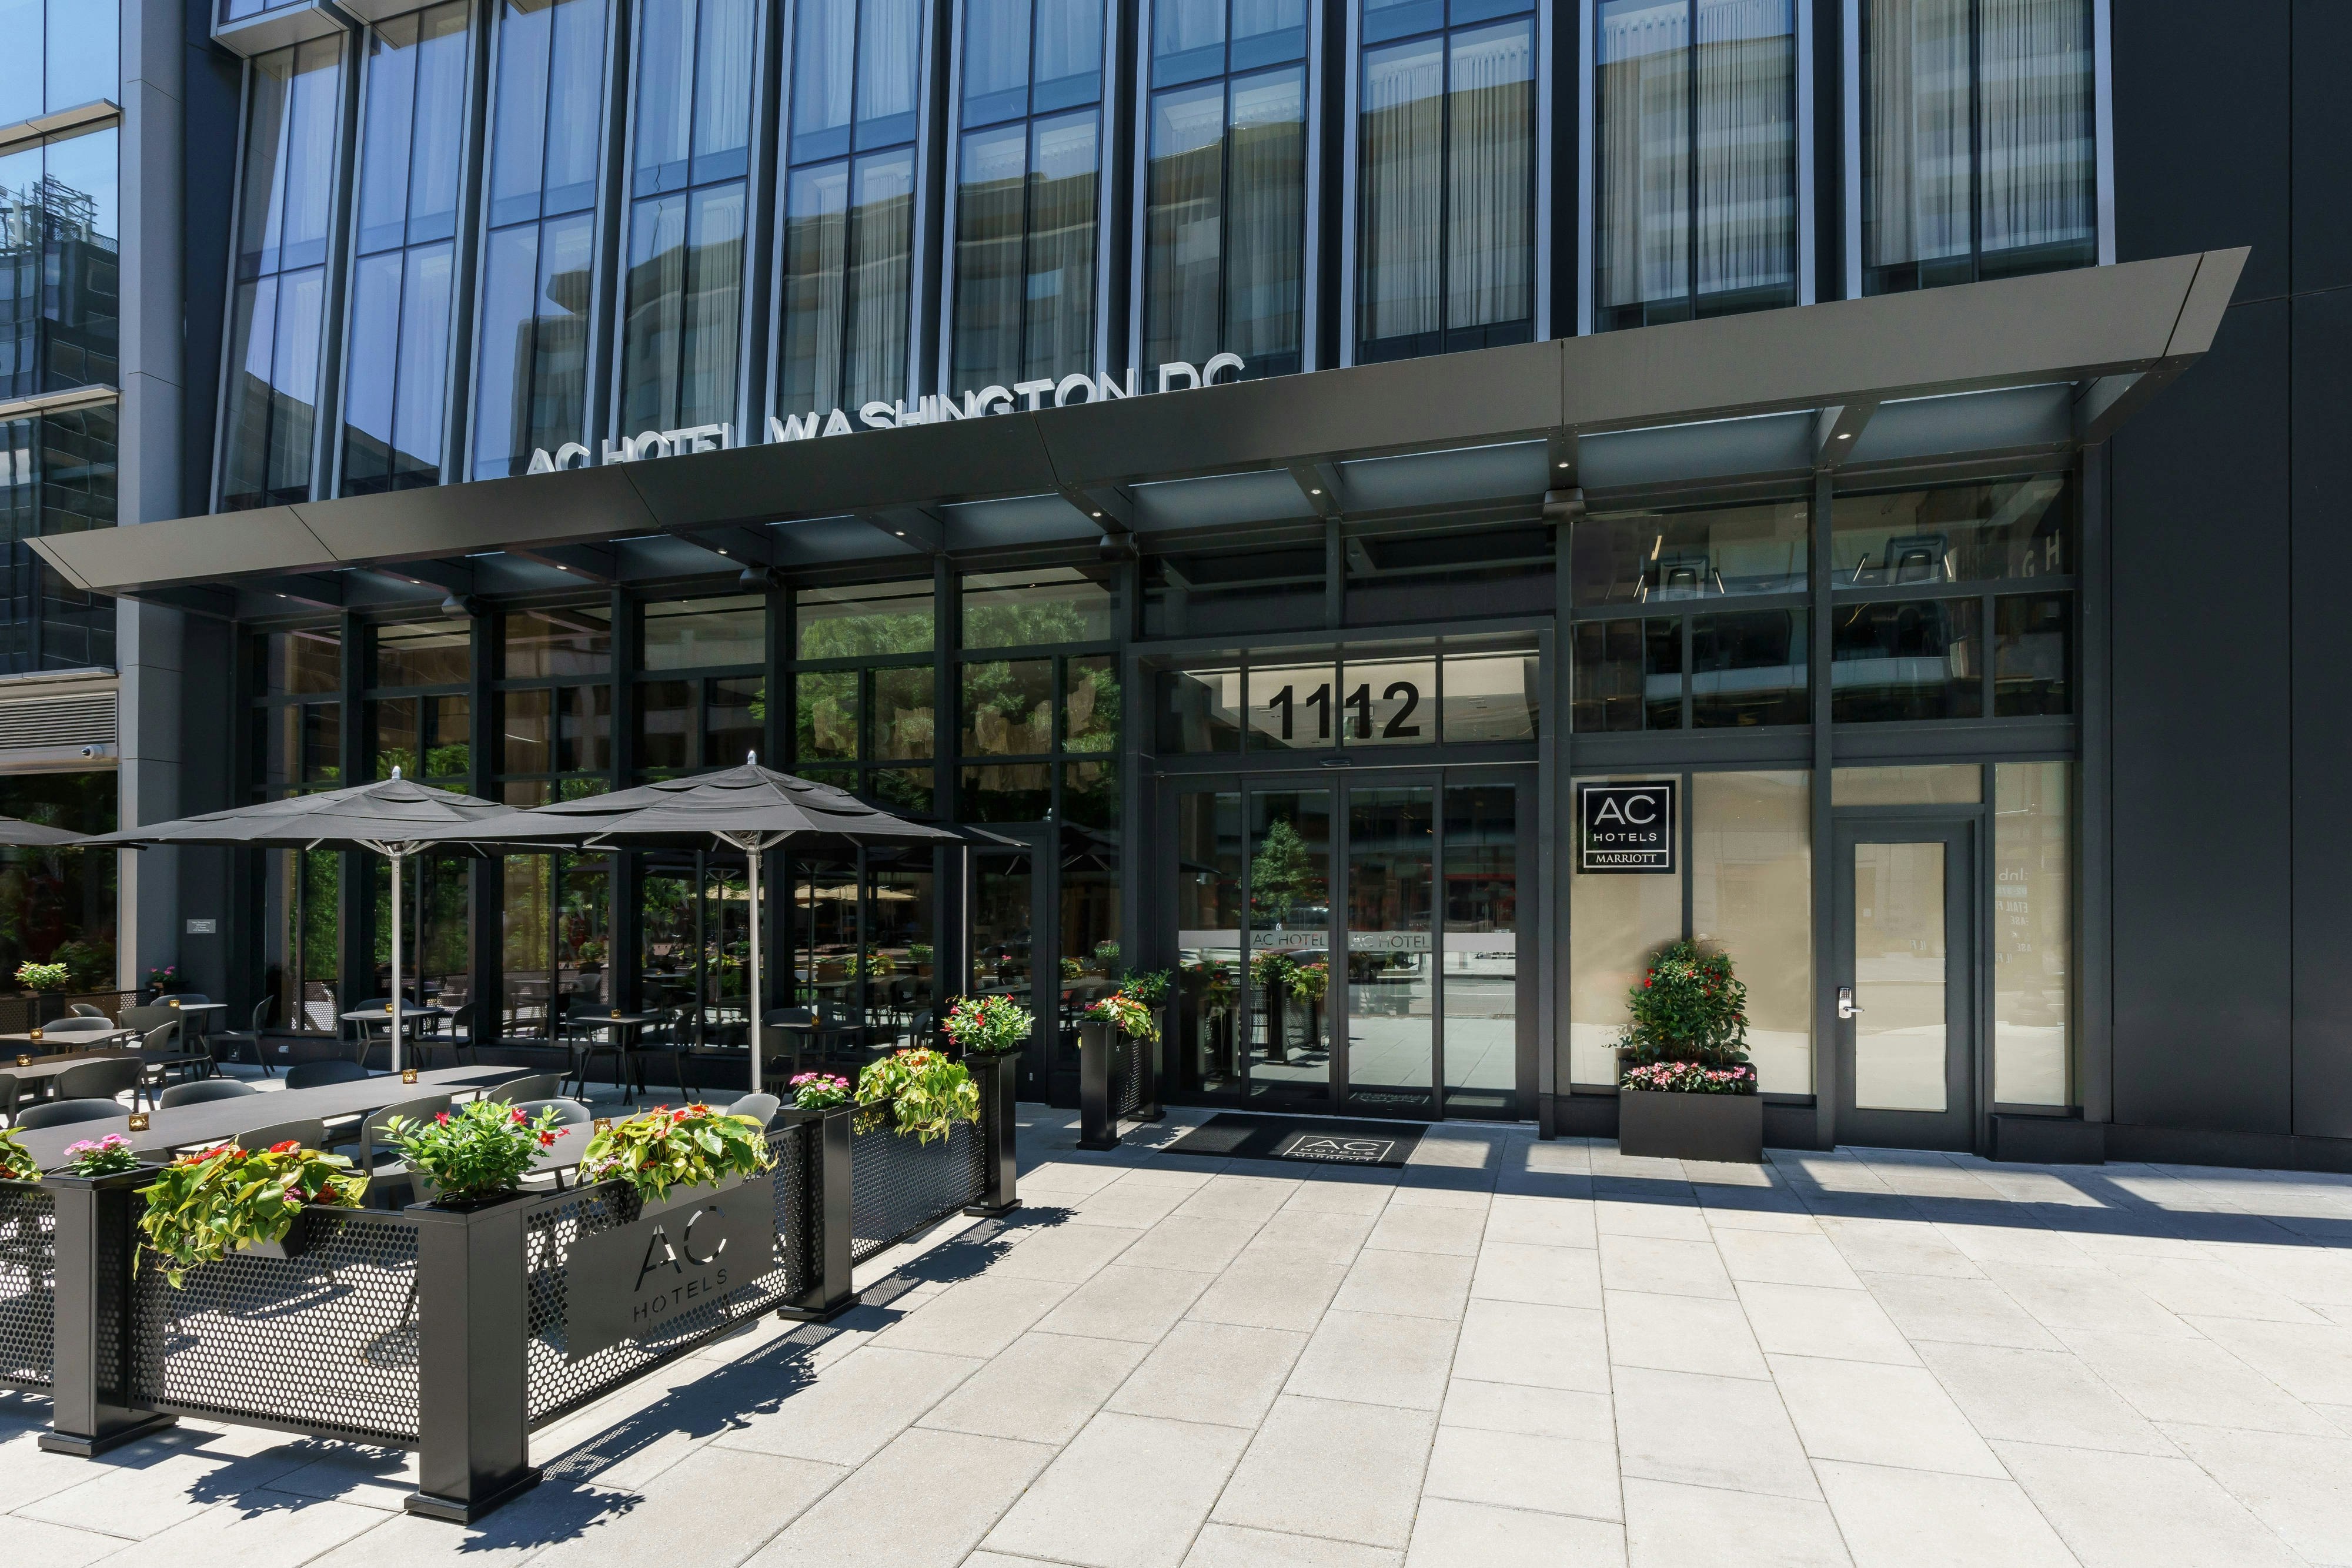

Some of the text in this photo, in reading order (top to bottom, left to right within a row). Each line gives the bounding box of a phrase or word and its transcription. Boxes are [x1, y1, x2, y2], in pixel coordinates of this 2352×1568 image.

[526, 353, 1245, 475] AC HOTEL WASHINGTON DC
[1269, 681, 1420, 740] 1112
[1594, 795, 1656, 825] AC
[1593, 833, 1657, 842] HOTELS
[1596, 854, 1657, 863] MARRIOTT
[1252, 933, 1326, 946] AC HOTEL
[1351, 935, 1431, 948] AC HOTEL
[1304, 1140, 1379, 1151] AC
[1294, 1153, 1375, 1161] MARRIOTT
[634, 1206, 727, 1292] AC
[634, 1268, 727, 1323] HOTELS
